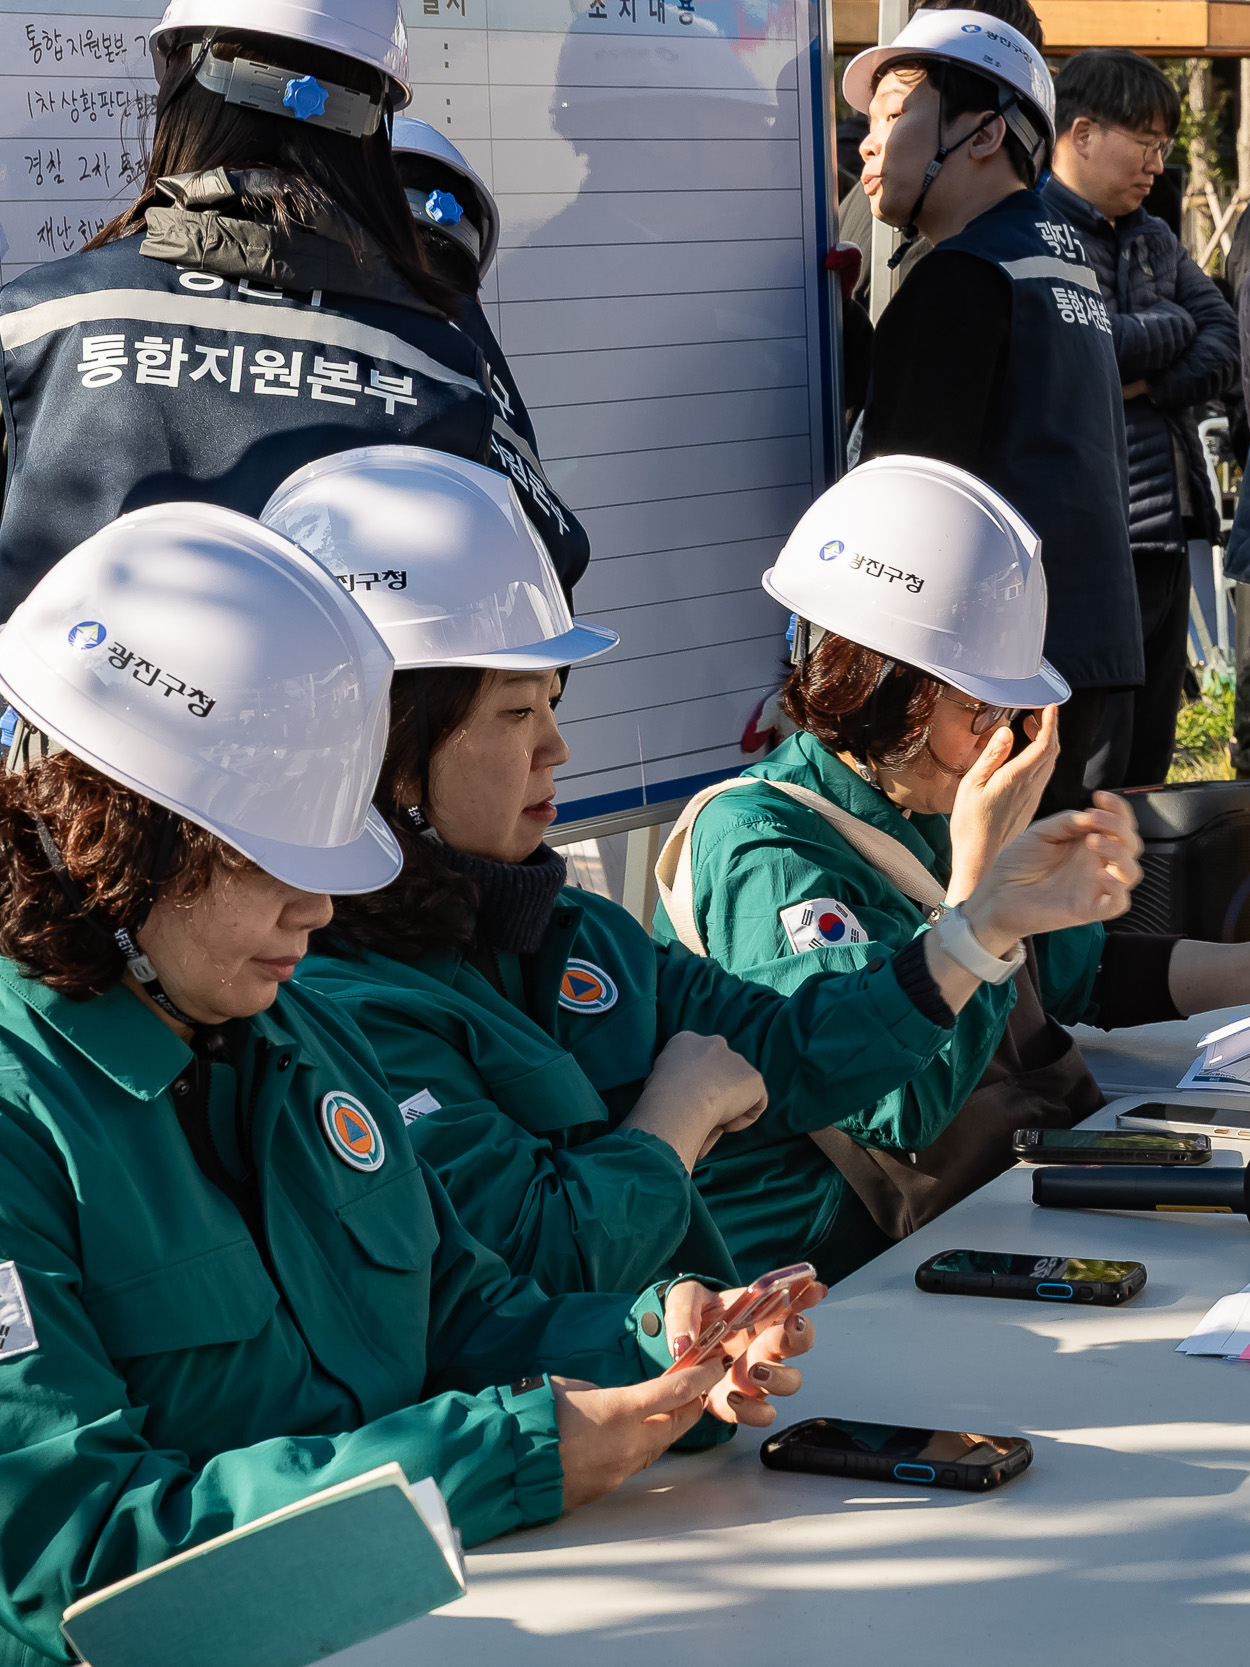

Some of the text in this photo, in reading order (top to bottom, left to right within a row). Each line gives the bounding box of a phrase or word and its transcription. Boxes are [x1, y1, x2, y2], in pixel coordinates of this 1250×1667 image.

[985, 30, 1034, 64] 광진구청
[25, 149, 65, 186] 경찰
[78, 151, 110, 188] 2차
[37, 215, 74, 252] 재난
[77, 334, 418, 415] 통합지원본부
[336, 569, 407, 592] 진구청
[848, 552, 925, 594] 광진구청
[107, 641, 218, 718] 광진구청
